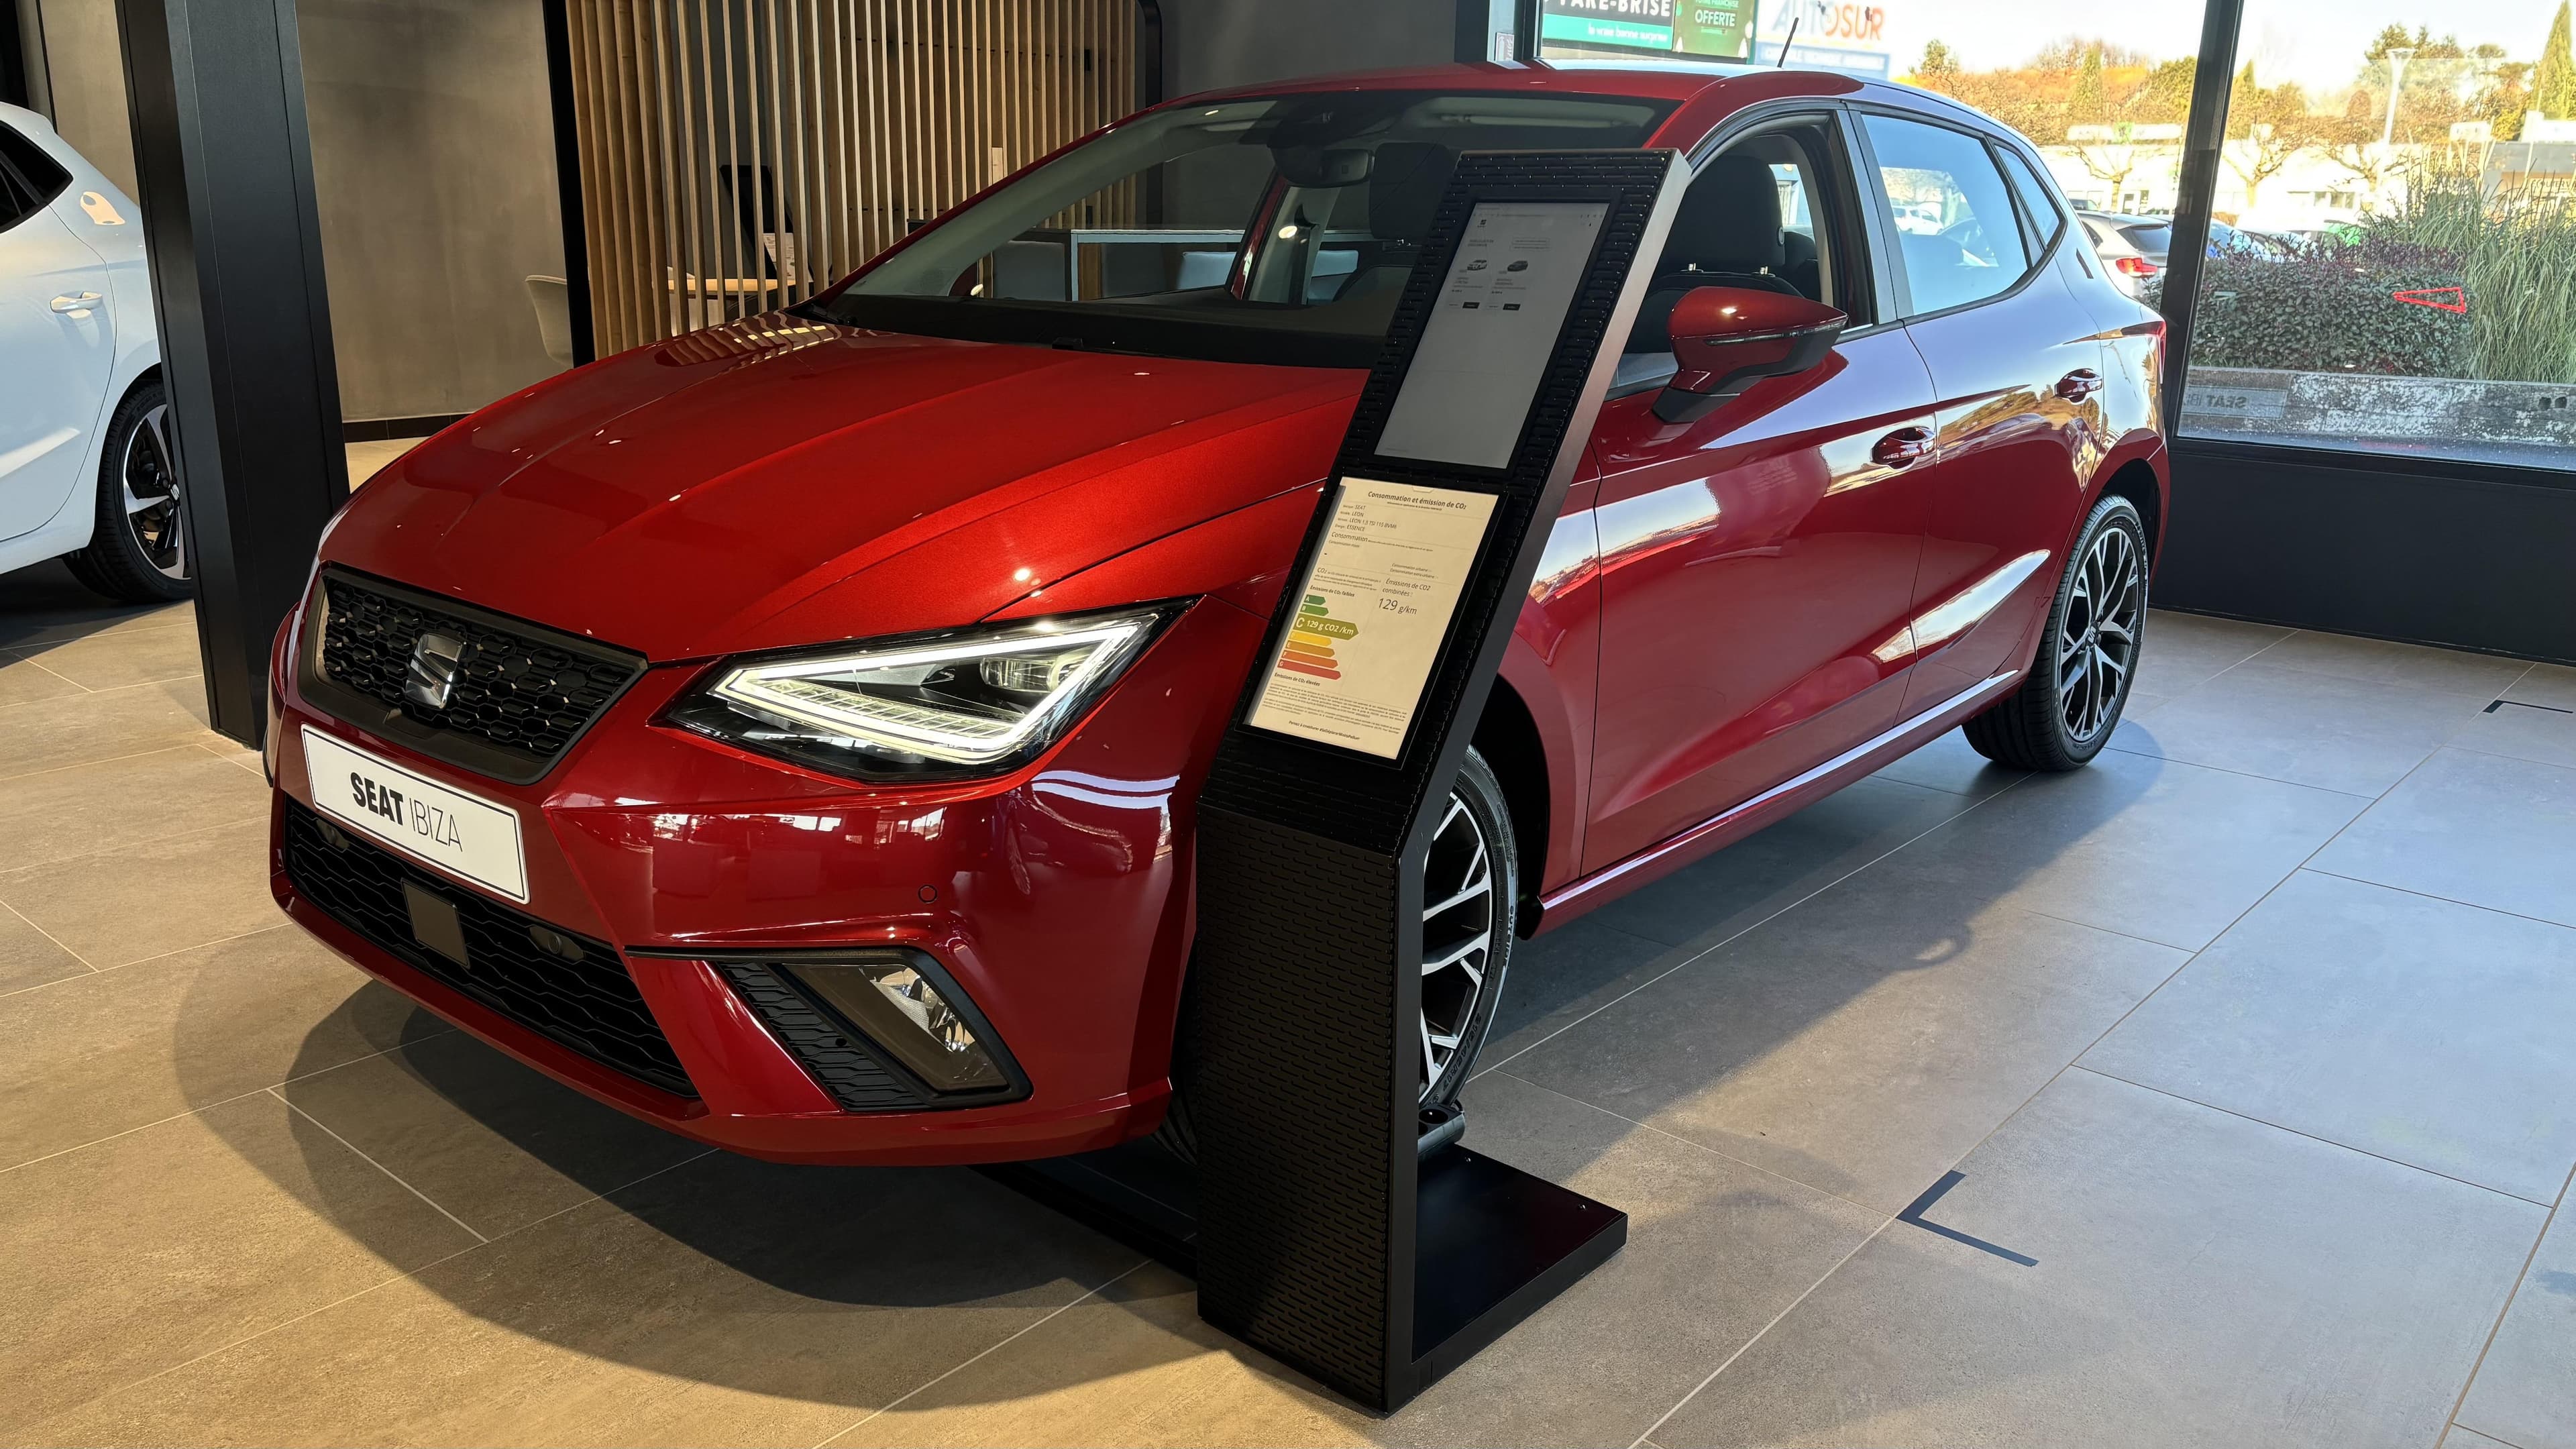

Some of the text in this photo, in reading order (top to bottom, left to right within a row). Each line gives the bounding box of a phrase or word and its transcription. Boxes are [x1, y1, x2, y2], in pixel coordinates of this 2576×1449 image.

[1695, 9, 1735, 26] OFFERTE
[1772, 0, 1884, 40] AUTOSUR
[1368, 491, 1411, 502] Consommation
[1419, 498, 1445, 506] émission
[1331, 531, 1368, 541] Consommation
[1385, 578, 1410, 588] Émissions
[1382, 588, 1409, 596] combinées
[1379, 598, 1417, 614] 129 g/km
[1296, 617, 1304, 627] C
[1324, 623, 1339, 632] CO2
[350, 771, 463, 853] SEAT IBIZA
